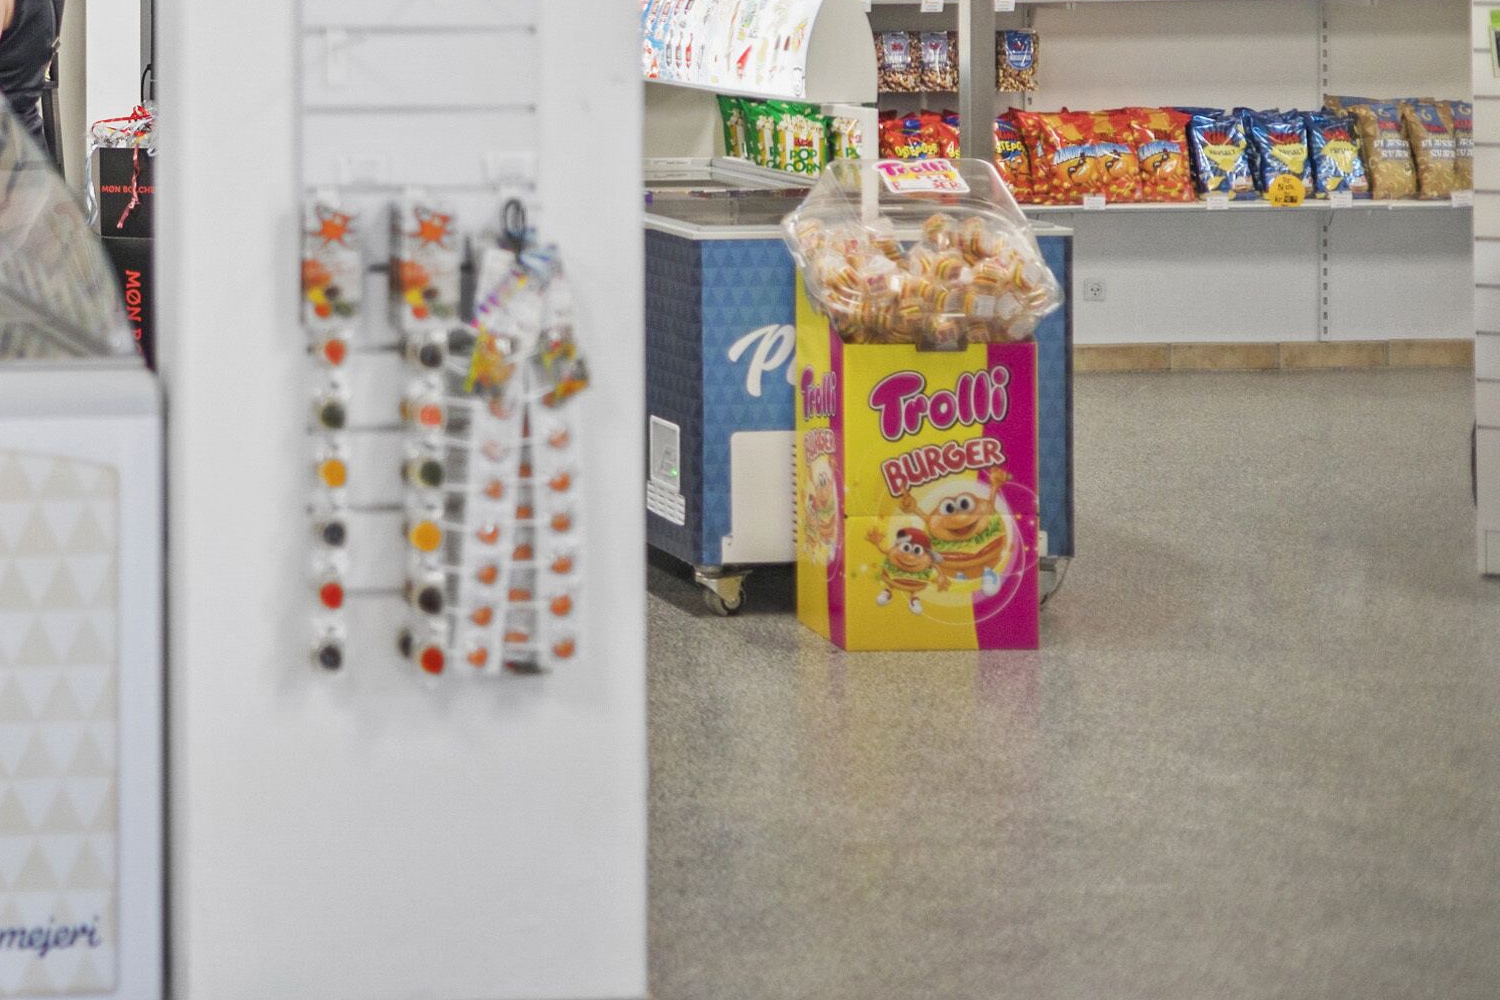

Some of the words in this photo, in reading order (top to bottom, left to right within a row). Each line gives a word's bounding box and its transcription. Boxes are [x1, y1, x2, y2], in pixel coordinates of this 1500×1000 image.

[784, 158, 821, 176] CORN
[789, 148, 818, 161] POP
[877, 161, 949, 177] Trolli
[125, 269, 142, 322] MØN
[728, 324, 796, 397] P
[801, 364, 837, 422] Trolli
[869, 365, 1011, 441] Trolli
[804, 428, 837, 467] BURGER
[881, 437, 1007, 498] BURGER
